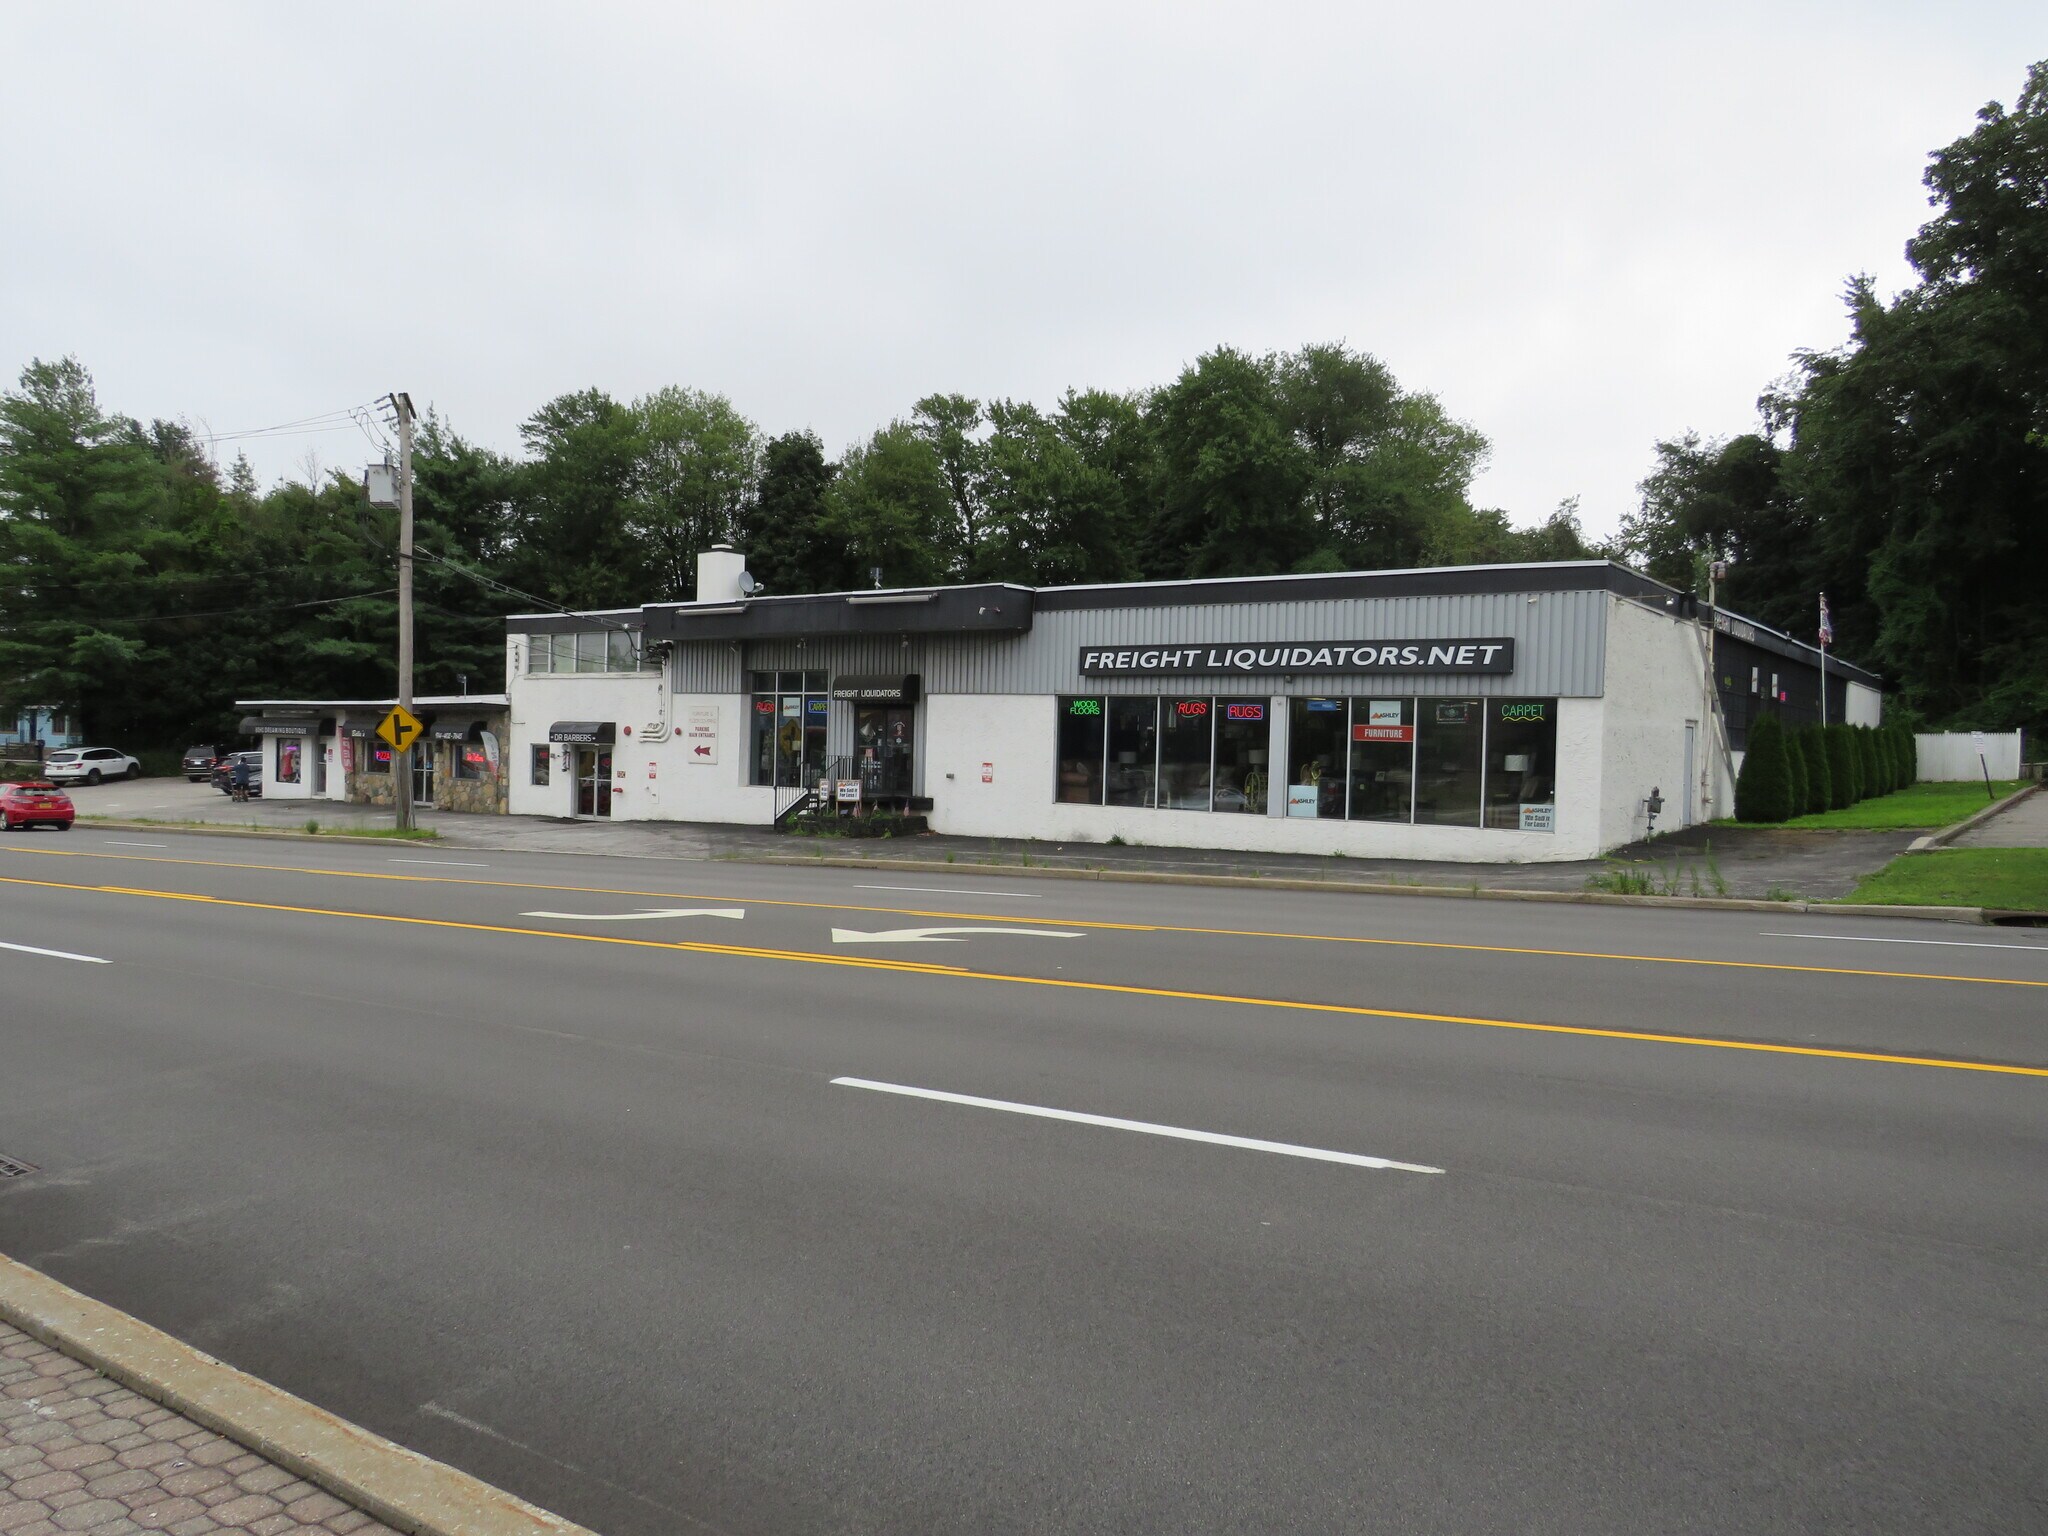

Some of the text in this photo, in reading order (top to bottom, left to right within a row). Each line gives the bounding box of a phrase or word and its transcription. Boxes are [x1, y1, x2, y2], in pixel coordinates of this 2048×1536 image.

[1083, 645, 1503, 671] FREIGHT LIQUIDATORS.NET
[834, 689, 901, 698] FREIGHT LIQUIDATORS
[756, 702, 775, 713] RUGS
[1073, 700, 1098, 708] WOOD
[1178, 703, 1207, 714] RUGS
[1070, 707, 1100, 716] FLOORS
[1229, 705, 1262, 718] RUGS
[1379, 712, 1400, 720] ASHLEY
[1501, 704, 1545, 717] CARPET
[554, 733, 592, 743] DR BARBERS
[1364, 728, 1403, 739] FURNITURE
